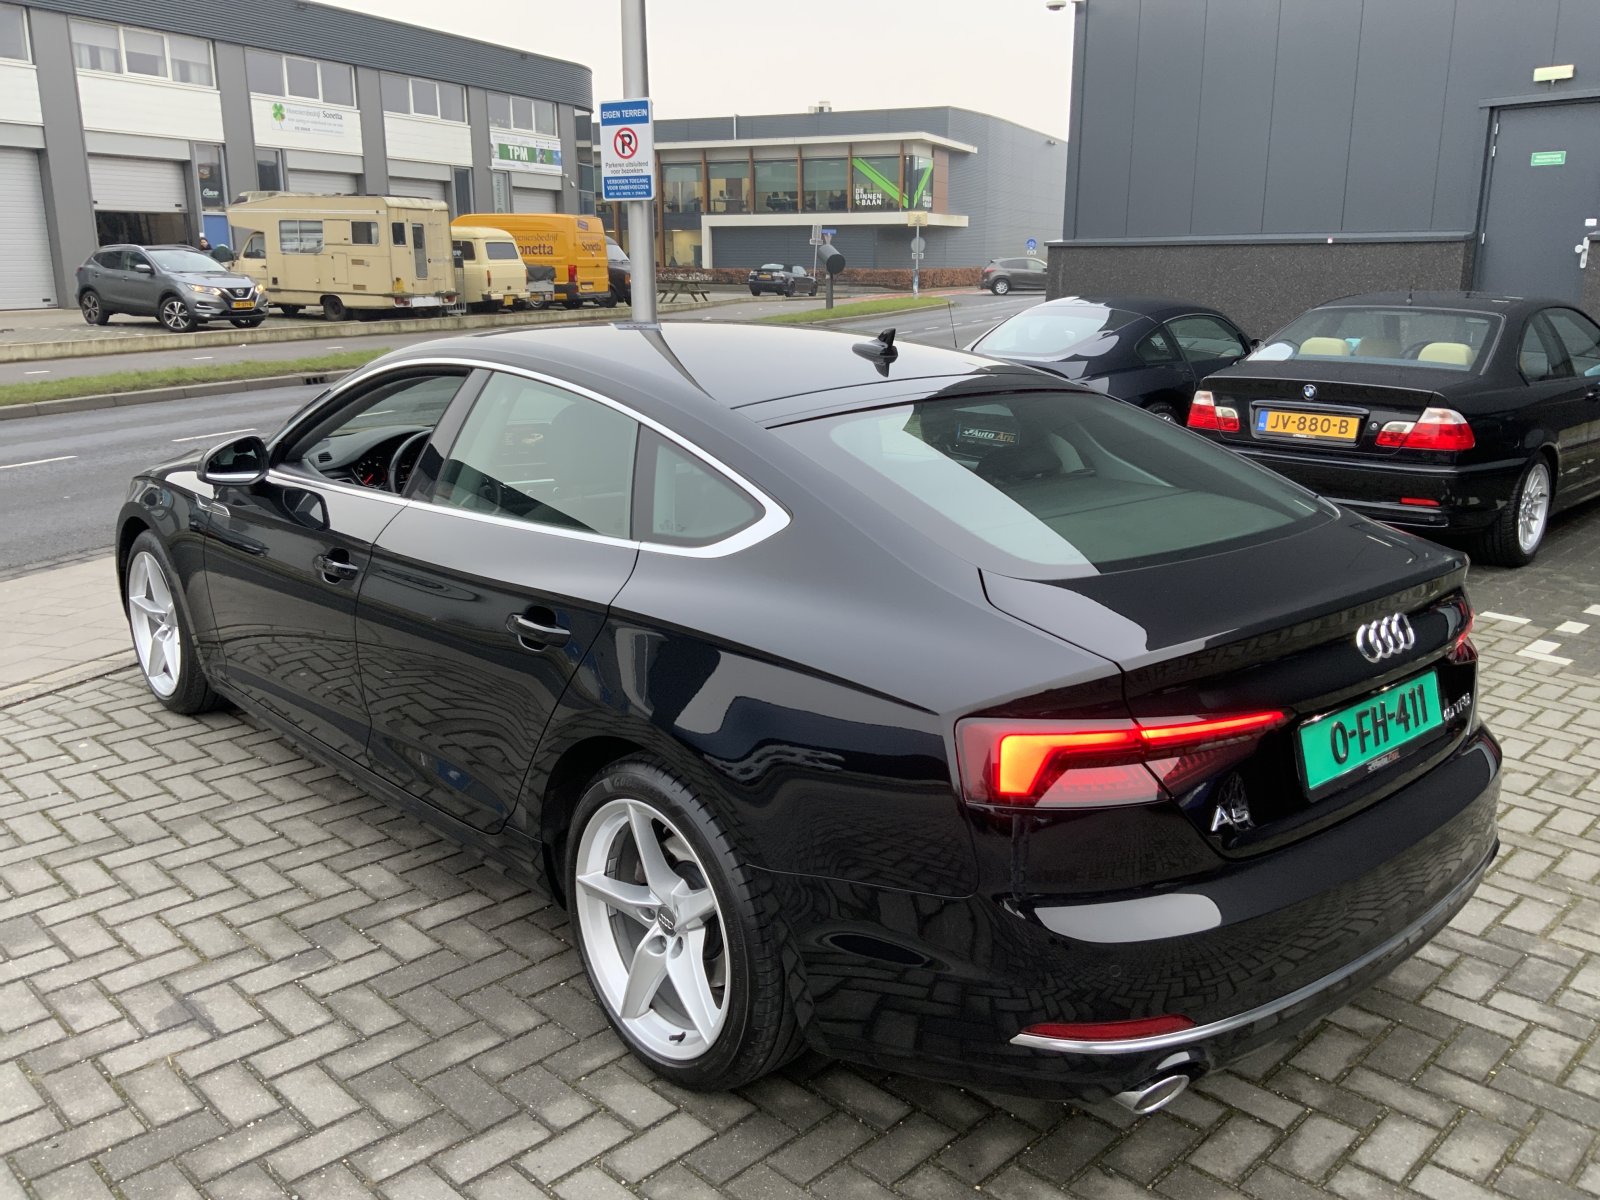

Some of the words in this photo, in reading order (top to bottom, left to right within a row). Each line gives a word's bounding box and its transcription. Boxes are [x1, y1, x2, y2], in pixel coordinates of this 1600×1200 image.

[322, 110, 344, 121] Sonetta
[602, 110, 621, 120] EIGEN
[621, 108, 648, 118] TERREIN
[507, 145, 529, 161] TPM
[518, 243, 554, 256] onetta
[581, 240, 603, 253] Sonetta
[1270, 414, 1350, 435] JV-880-B
[971, 430, 995, 440] Auto
[1210, 804, 1249, 832] A5
